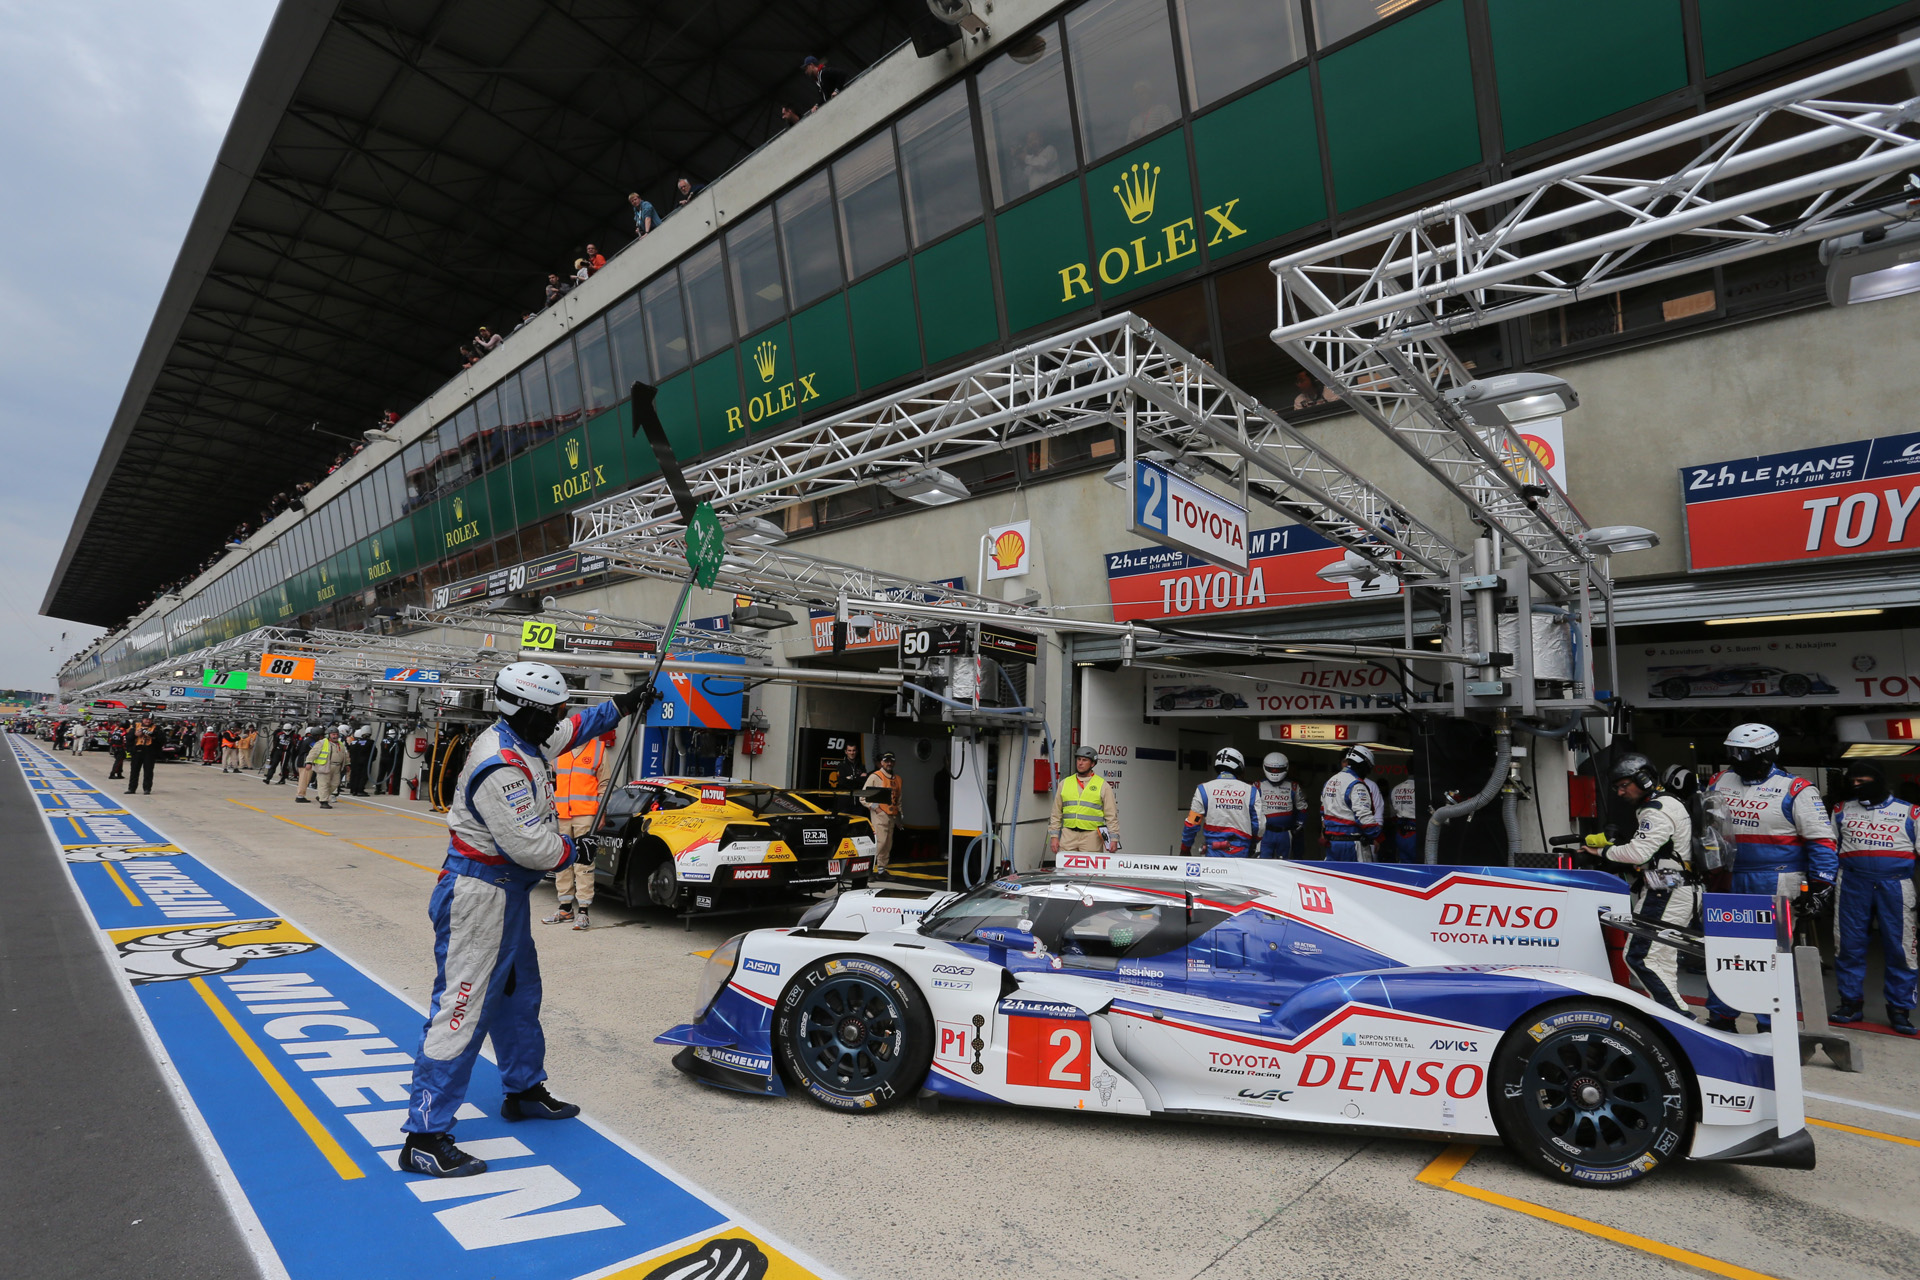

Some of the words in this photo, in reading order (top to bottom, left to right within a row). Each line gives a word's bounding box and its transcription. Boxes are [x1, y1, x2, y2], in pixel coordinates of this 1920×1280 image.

[1058, 198, 1247, 302] ROLEX
[725, 371, 820, 433] ROLEX
[1689, 465, 1734, 490] 24h
[1740, 467, 1771, 483] LE
[1776, 454, 1855, 478] MANS
[1775, 477, 1800, 487] 13-14
[1805, 473, 1824, 483] JUIN
[1830, 469, 1852, 480] 2015
[552, 465, 606, 504] ROLEX
[1142, 468, 1163, 531] 2
[1171, 493, 1244, 551] TOYOTA
[446, 520, 480, 548] ROLEX
[694, 519, 706, 545] 2
[699, 524, 715, 562] IGNITION
[1270, 530, 1289, 551] P1
[1110, 554, 1131, 570] 24h
[1134, 556, 1148, 566] LE
[1149, 551, 1183, 564] MANS
[368, 559, 392, 581] ROLEX
[508, 565, 525, 592] 50
[317, 584, 336, 602] ROLEX
[1160, 566, 1266, 614] TOYOTA
[436, 587, 449, 610] 50
[525, 624, 553, 645] 50
[568, 637, 614, 647] LARBRE
[904, 631, 930, 655] 50
[270, 659, 294, 675] 88
[213, 673, 230, 685] 77
[418, 670, 439, 680] 36
[1300, 669, 1388, 688] DENSO
[515, 678, 537, 689] TOYOTA
[1754, 683, 1763, 693] 1
[151, 689, 161, 697] 13
[171, 687, 185, 696] 29
[1257, 695, 1335, 710] TOYOTA
[662, 702, 674, 719] 36
[1283, 727, 1290, 737] 2
[1338, 727, 1345, 737] 2
[1895, 721, 1905, 737] 1
[826, 737, 845, 750] 50
[1098, 744, 1128, 757] DENSO
[502, 779, 525, 794] JTEKT
[1212, 789, 1246, 797] DENSO
[515, 803, 532, 814] ZENT
[1725, 797, 1769, 810] DENSO
[1729, 809, 1760, 820] YOTA
[1731, 818, 1760, 828] BRID
[1846, 820, 1900, 833] DENSO
[1850, 830, 1894, 842] TOYOTA
[1850, 838, 1894, 848] HYBRID
[829, 861, 840, 873] AM
[851, 861, 870, 872] MOTUL
[1063, 854, 1111, 870] ZENT
[733, 869, 770, 879] MOTUL
[1187, 865, 1200, 873] ZF
[1202, 867, 1228, 876] zf.com
[119, 861, 237, 918] MICHELIN
[1301, 887, 1328, 908] HY
[872, 906, 901, 914] TOYOTA
[1438, 903, 1558, 930] DENSO
[1707, 908, 1754, 924] Mobil
[976, 930, 996, 940] Mobil
[1430, 932, 1488, 945] TOYOTA
[1492, 935, 1560, 947] HYBRID
[745, 960, 779, 974] AISIN
[846, 961, 890, 980] MICHELIN
[933, 965, 975, 976] RAYS
[1118, 965, 1164, 979] NISSHINBO
[1715, 957, 1768, 972] JTEKT
[806, 970, 826, 987] FL
[933, 980, 971, 990] 林テレンプ
[449, 981, 472, 1031] DENSO
[1002, 999, 1025, 1010] 24h
[1027, 1003, 1041, 1011] LE
[1043, 1003, 1077, 1013] MANS
[1553, 1012, 1610, 1026] MICHELIN
[941, 1028, 966, 1057] P1
[1359, 1040, 1393, 1048] SUMITOMO
[1429, 1039, 1478, 1052] ADVICS
[1602, 1037, 1632, 1055] RAYS
[711, 1048, 770, 1071] MICHELIN
[1049, 1028, 1082, 1083] 2
[1209, 1052, 1281, 1070] TOYOTA
[1247, 1070, 1281, 1079] Racing
[1297, 1053, 1484, 1100] DENSO
[811, 1087, 854, 1107] MICHELIN
[1238, 1088, 1294, 1102] WEC
[1706, 1093, 1747, 1108] TMG
[221, 972, 627, 1251] MICHELIN
[1574, 1168, 1633, 1181] MICHELIN
